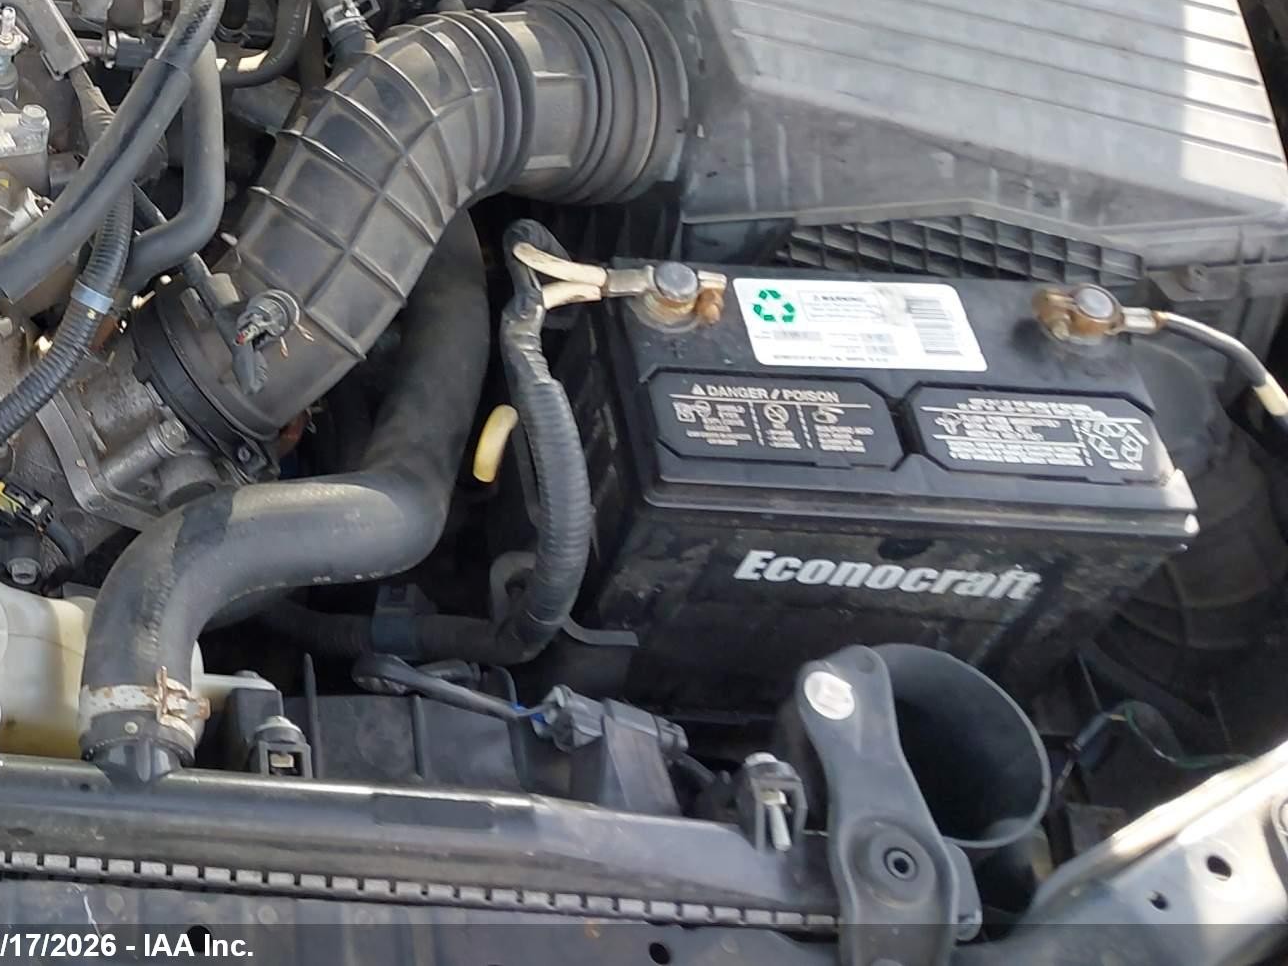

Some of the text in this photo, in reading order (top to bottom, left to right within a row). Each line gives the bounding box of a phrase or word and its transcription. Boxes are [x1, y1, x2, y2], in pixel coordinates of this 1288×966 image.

[707, 384, 769, 400] DANGER
[782, 389, 841, 403] POISON
[734, 550, 1042, 601] Econocraft
